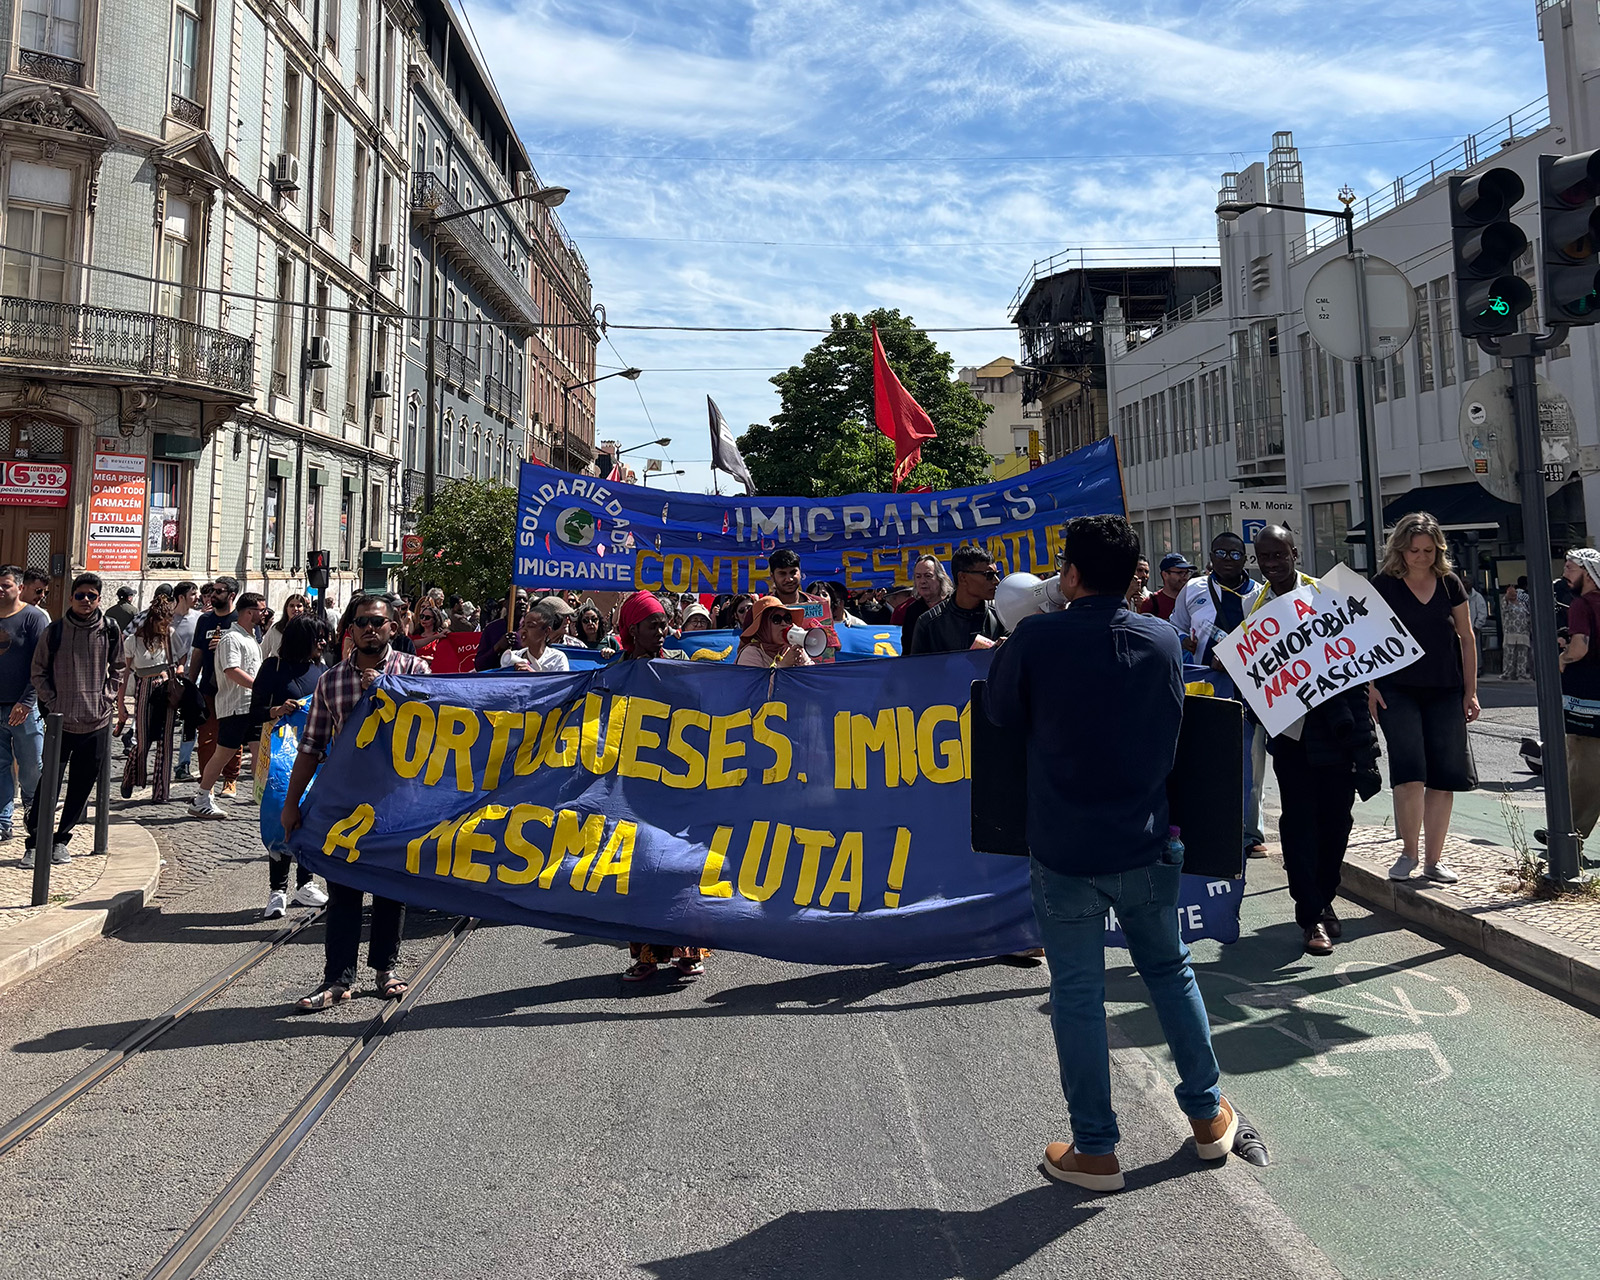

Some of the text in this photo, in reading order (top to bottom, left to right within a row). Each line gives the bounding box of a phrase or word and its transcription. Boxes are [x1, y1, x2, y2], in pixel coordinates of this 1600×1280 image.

[93, 485, 145, 495] O ANO TODO
[94, 473, 145, 484] MEGA PREÇOS
[94, 497, 142, 509] ARMAZÉM
[1251, 501, 1261, 509] M.
[1266, 501, 1293, 509] Moniz
[91, 512, 142, 522] TEXTIL LAR
[520, 479, 631, 554] SOLIDARIEDADE
[518, 557, 632, 581] IMIGRANTE
[634, 549, 803, 594] CONTR
[1236, 598, 1317, 666] NÃO A
[1263, 637, 1356, 708] NÃO AO
[321, 803, 376, 863] A
[405, 803, 638, 895] MESMA
[699, 820, 864, 912] LUTA
